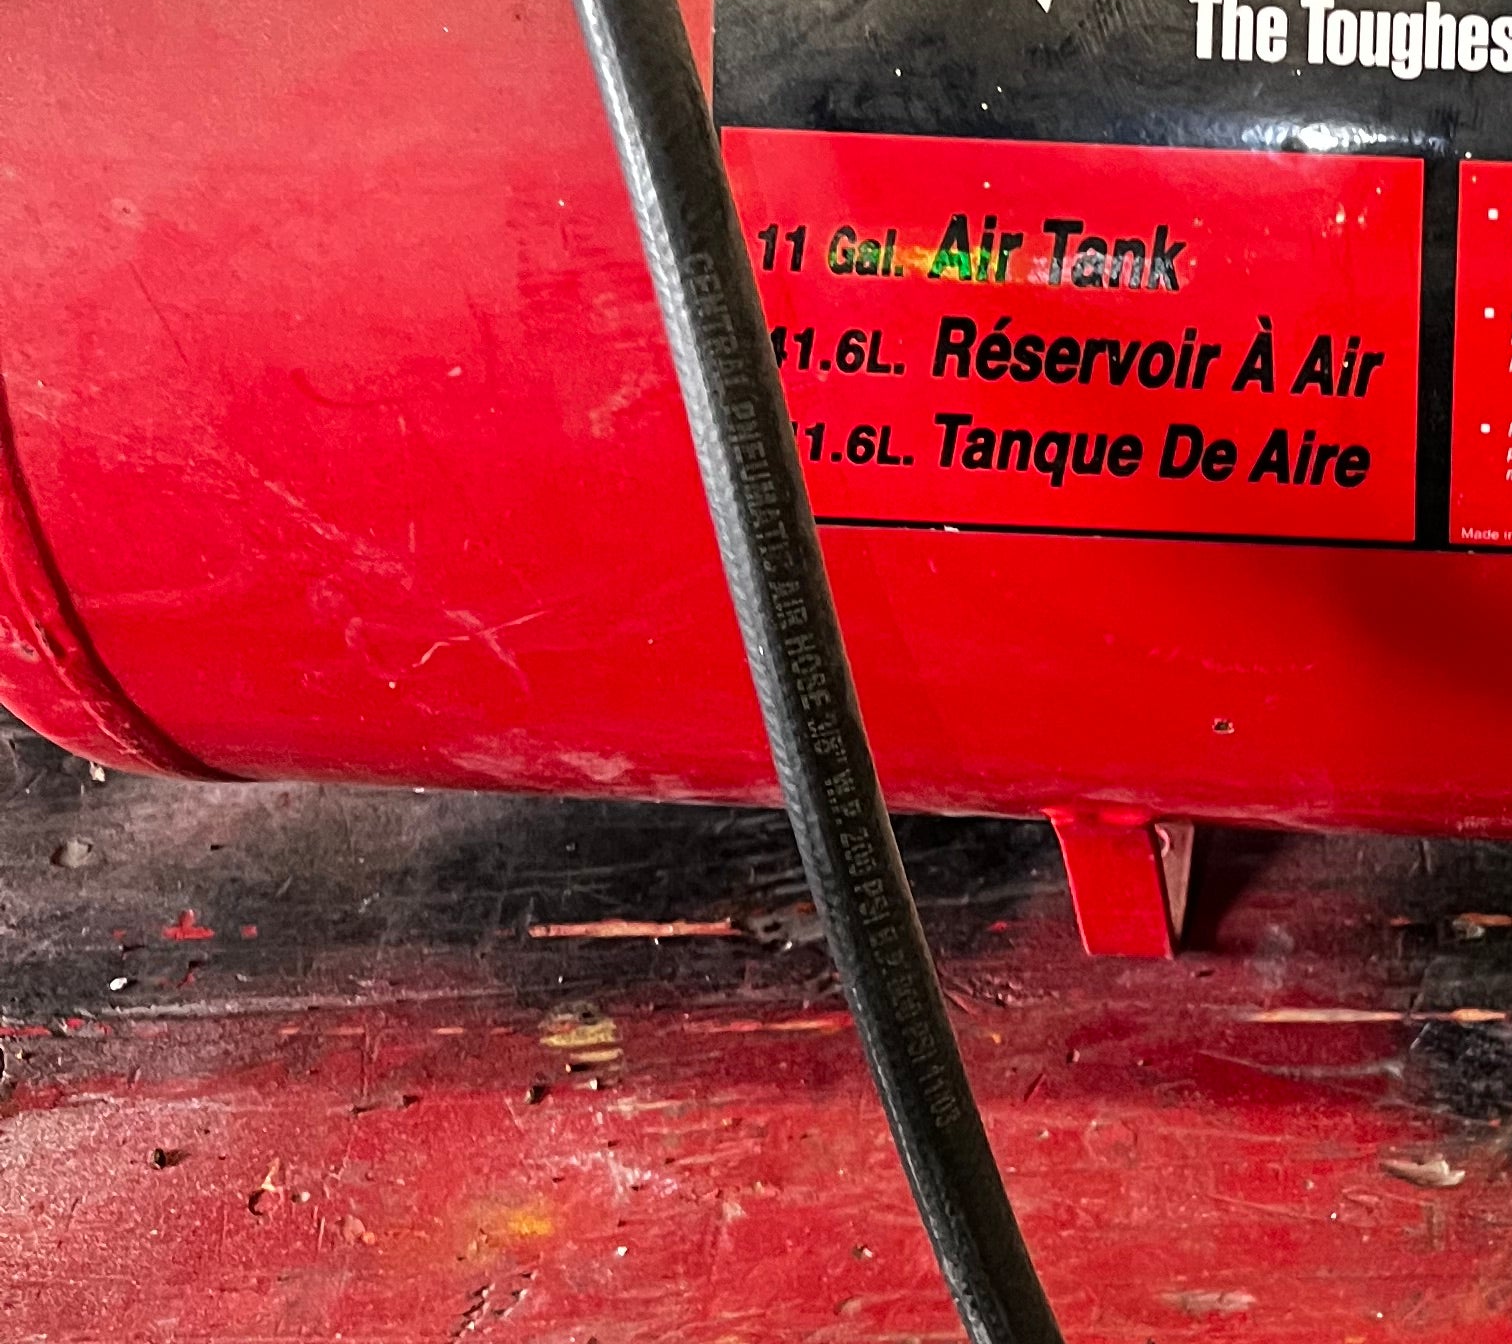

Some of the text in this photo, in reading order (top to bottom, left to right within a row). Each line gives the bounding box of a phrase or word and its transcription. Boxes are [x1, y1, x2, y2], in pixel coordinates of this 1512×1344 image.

[757, 213, 1189, 292] 11 Gal. Air Tank
[683, 251, 747, 390] CENTRAL
[931, 315, 1222, 388] Réservoir
[1230, 315, 1277, 394] À
[1291, 335, 1386, 398] Air
[726, 399, 794, 575] PNEUMATIC
[791, 413, 1372, 488] 1.6L. Tanque De Aire
[1460, 527, 1500, 541] Made
[767, 574, 809, 630] AIR
[782, 631, 832, 712] HOSE
[851, 876, 892, 925] PSI
